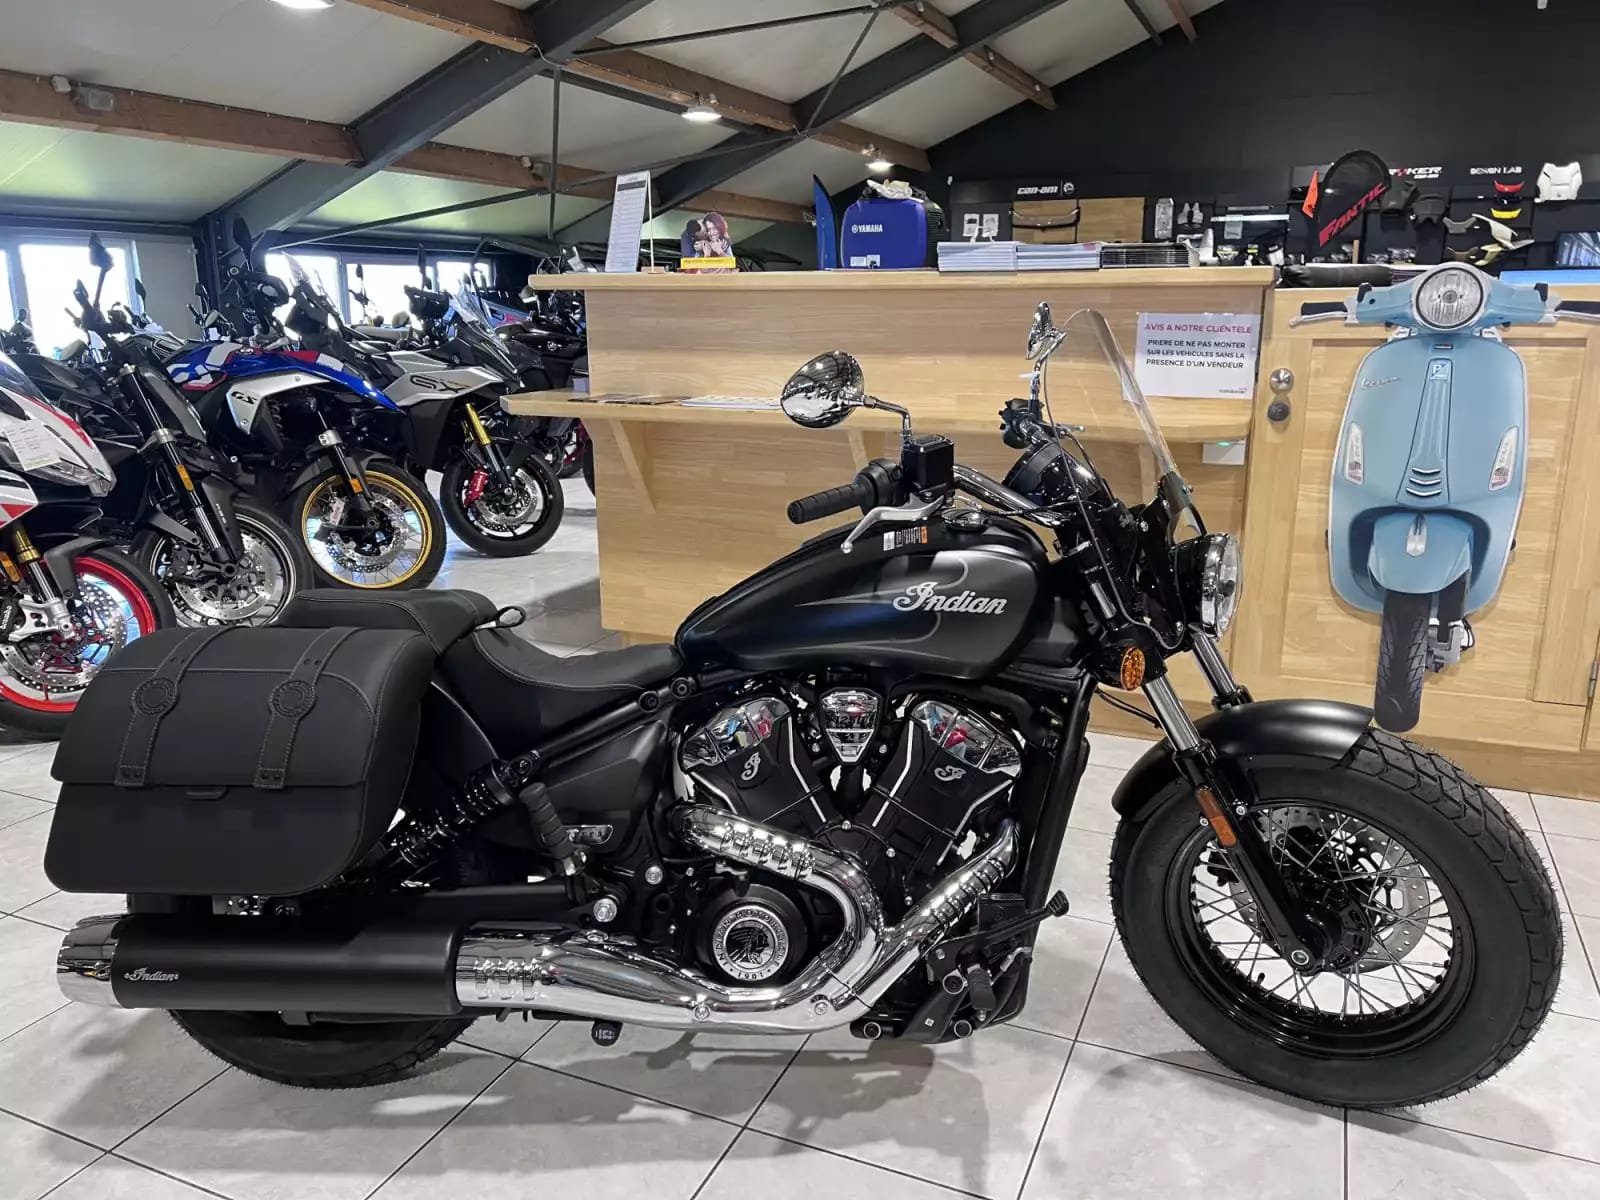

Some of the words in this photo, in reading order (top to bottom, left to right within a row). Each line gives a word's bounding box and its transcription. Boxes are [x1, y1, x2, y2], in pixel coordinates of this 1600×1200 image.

[1503, 166, 1522, 174] LAB
[1016, 185, 1059, 195] can-am
[1318, 183, 1387, 247] FANTIC
[858, 223, 884, 233] YAMAHA
[1145, 323, 1165, 332] AVIS
[1166, 323, 1173, 331] A
[1174, 324, 1204, 332] NOTRE
[1205, 325, 1253, 334] CLIENTELE
[1197, 340, 1212, 348] PAS
[1213, 341, 1246, 349] MONTER
[1176, 349, 1214, 357] VEHICULES
[1146, 358, 1184, 367] PRESENCE
[1207, 361, 1244, 369] VENDEUR
[892, 581, 1008, 615] Indian
[125, 967, 178, 981] Indian
